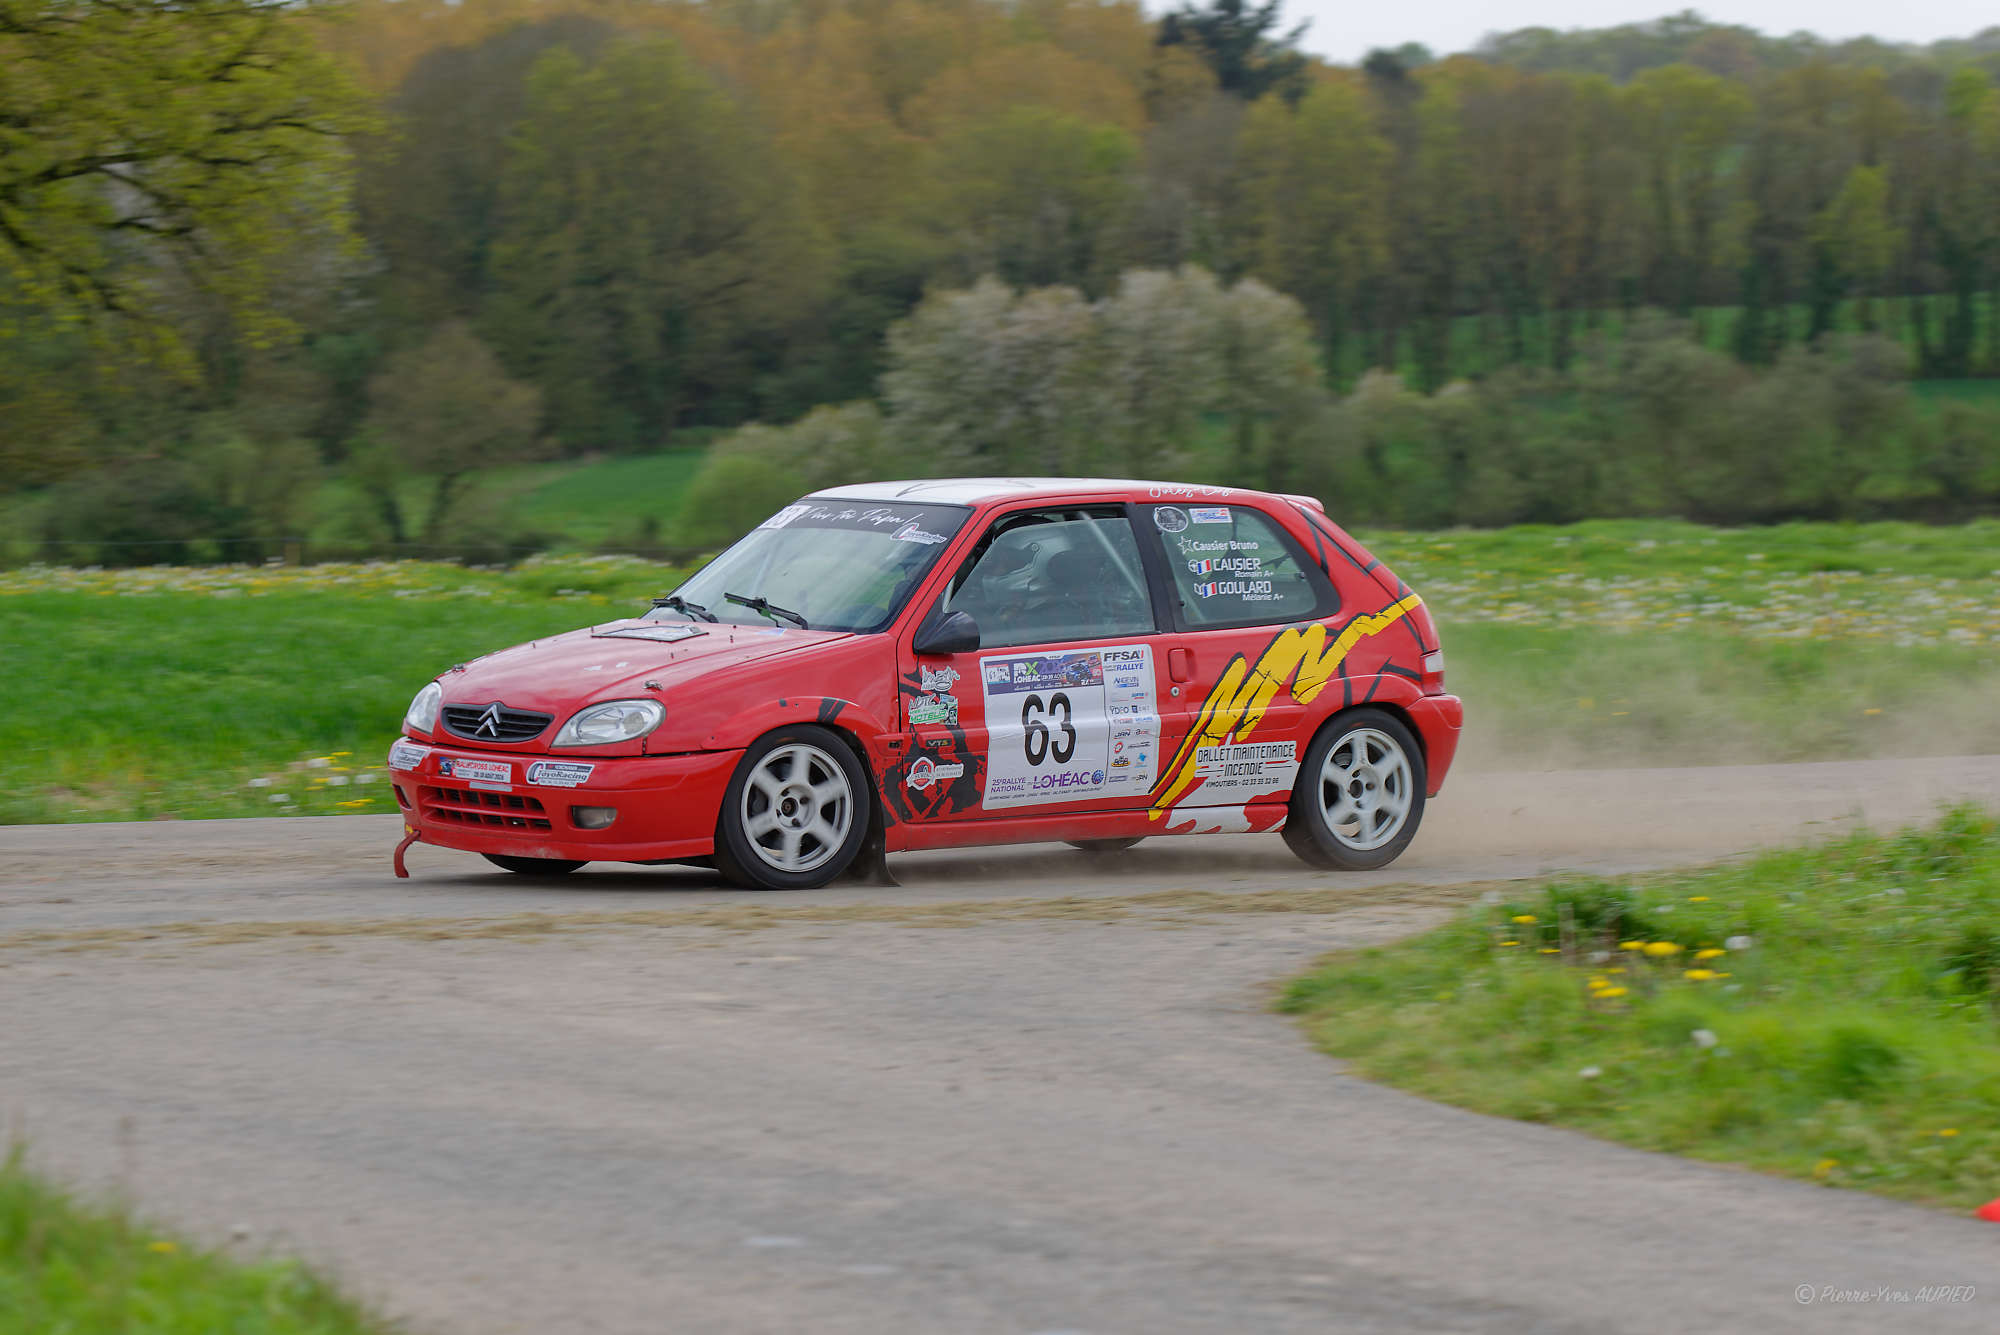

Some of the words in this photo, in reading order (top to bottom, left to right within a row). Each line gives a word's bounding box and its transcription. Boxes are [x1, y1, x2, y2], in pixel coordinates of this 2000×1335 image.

[1193, 541, 1228, 551] Causier
[1229, 541, 1258, 550] Bruno
[1213, 558, 1261, 571] CAUSIER
[1218, 581, 1272, 594] GOULARD
[1243, 593, 1272, 601] Mélanie
[1273, 593, 1283, 601] A+
[1104, 651, 1140, 662] FFSA
[1117, 663, 1144, 671] RALLYE
[1022, 692, 1076, 766] 63
[1198, 748, 1231, 762] DALLET
[1233, 744, 1295, 760] MAINTENANCE
[1225, 762, 1263, 776] INCENDIE
[1002, 777, 1026, 785] RALLYE
[1033, 771, 1091, 789] LOHÉAC
[1206, 780, 1238, 788] VIMOUTIERS
